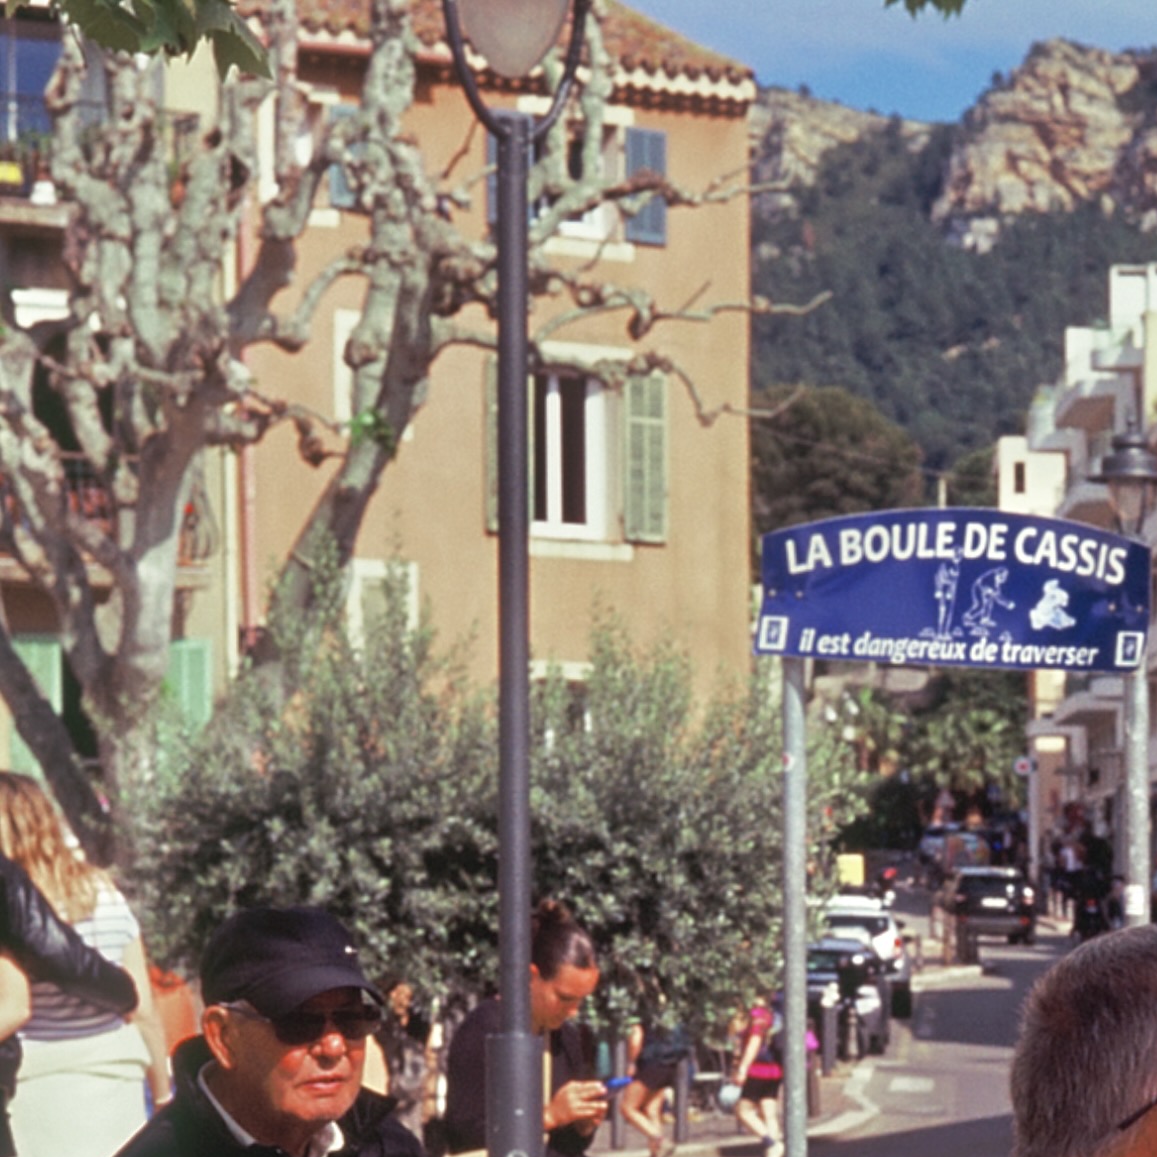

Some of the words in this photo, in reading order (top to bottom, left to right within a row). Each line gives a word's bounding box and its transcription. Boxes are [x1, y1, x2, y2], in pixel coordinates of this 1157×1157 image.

[785, 533, 833, 574] LA
[839, 521, 956, 566] BOULE
[963, 521, 1008, 560] DE
[1014, 526, 1128, 585] CASSIS
[799, 628, 816, 653] il
[816, 632, 850, 655] est
[853, 630, 967, 664] dangereux
[969, 636, 999, 662] de
[1000, 642, 1099, 666] traverser
